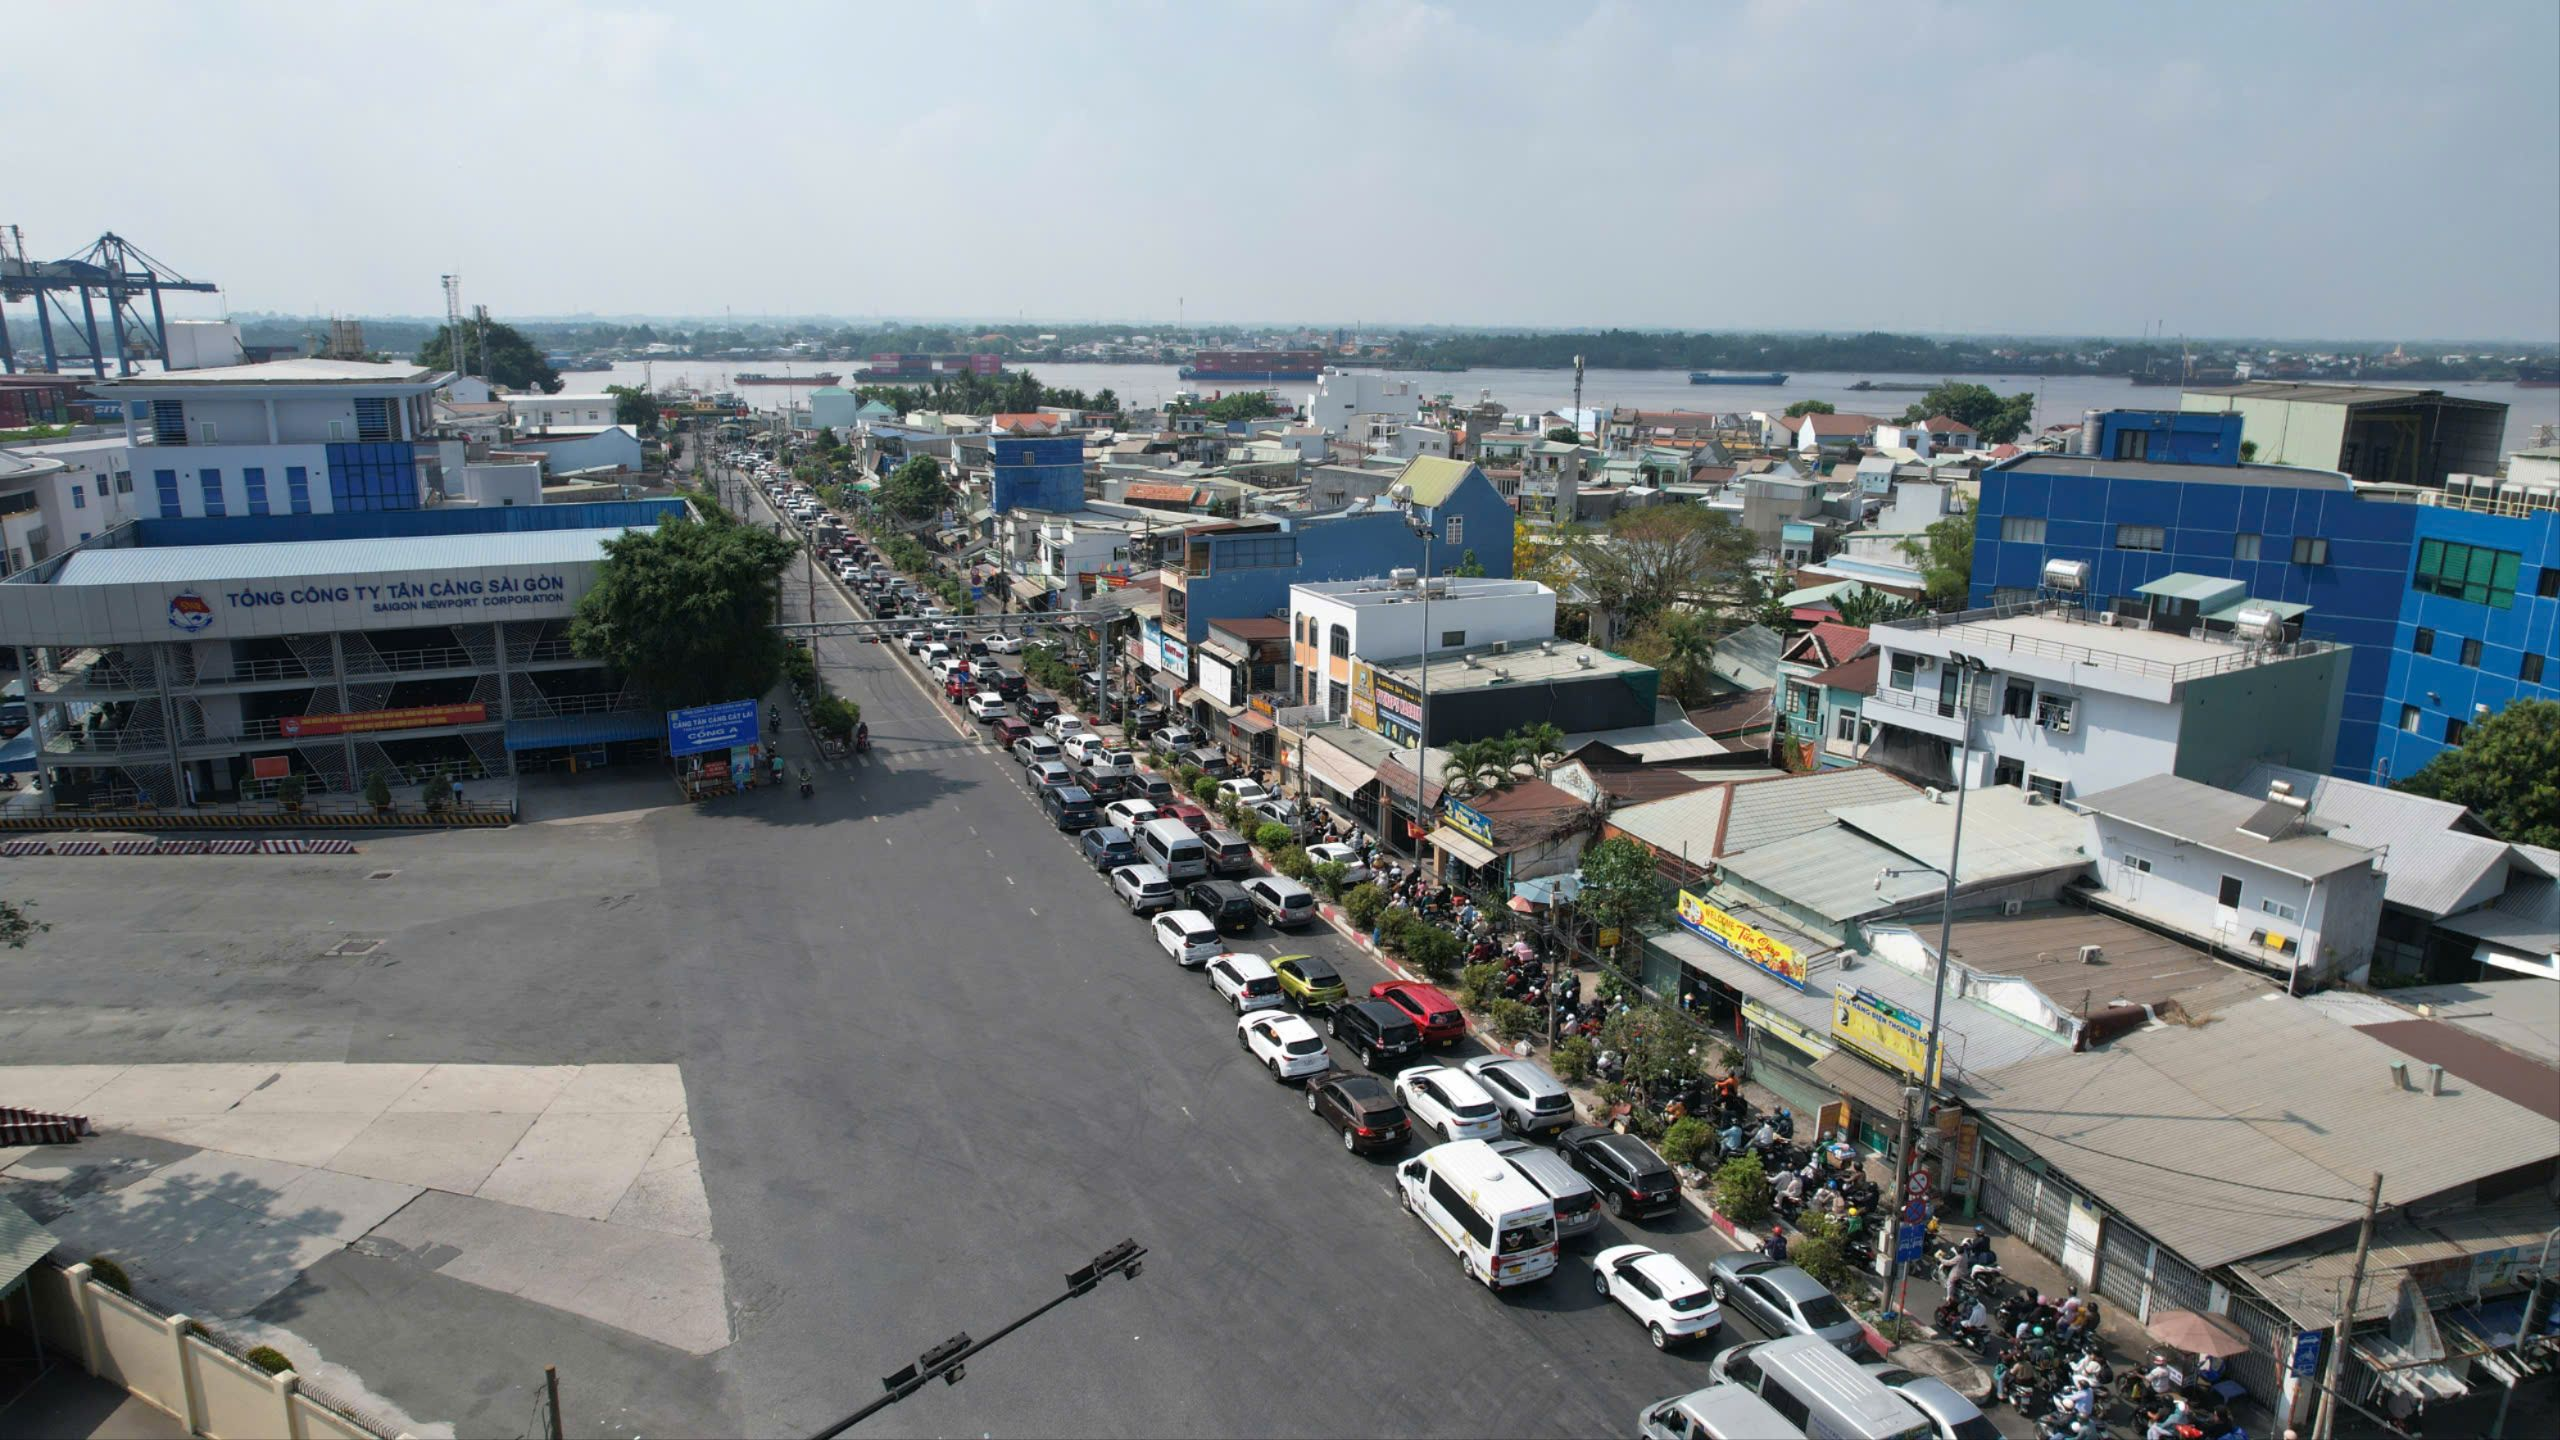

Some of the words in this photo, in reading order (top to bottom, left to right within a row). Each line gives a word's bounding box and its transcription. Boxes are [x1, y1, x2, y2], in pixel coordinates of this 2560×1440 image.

[226, 588, 286, 608] TỔNG
[290, 586, 349, 604] CÔNG
[354, 586, 380, 600] TY
[387, 582, 424, 598] TÂN
[430, 578, 483, 596] CẢNG
[488, 576, 518, 592] SÀI
[523, 574, 564, 592] GÒN
[373, 602, 418, 612] SAIGON
[422, 598, 478, 610] NEWPORT
[484, 593, 564, 606] CORPORATION
[1705, 908, 1735, 930] WELCOME
